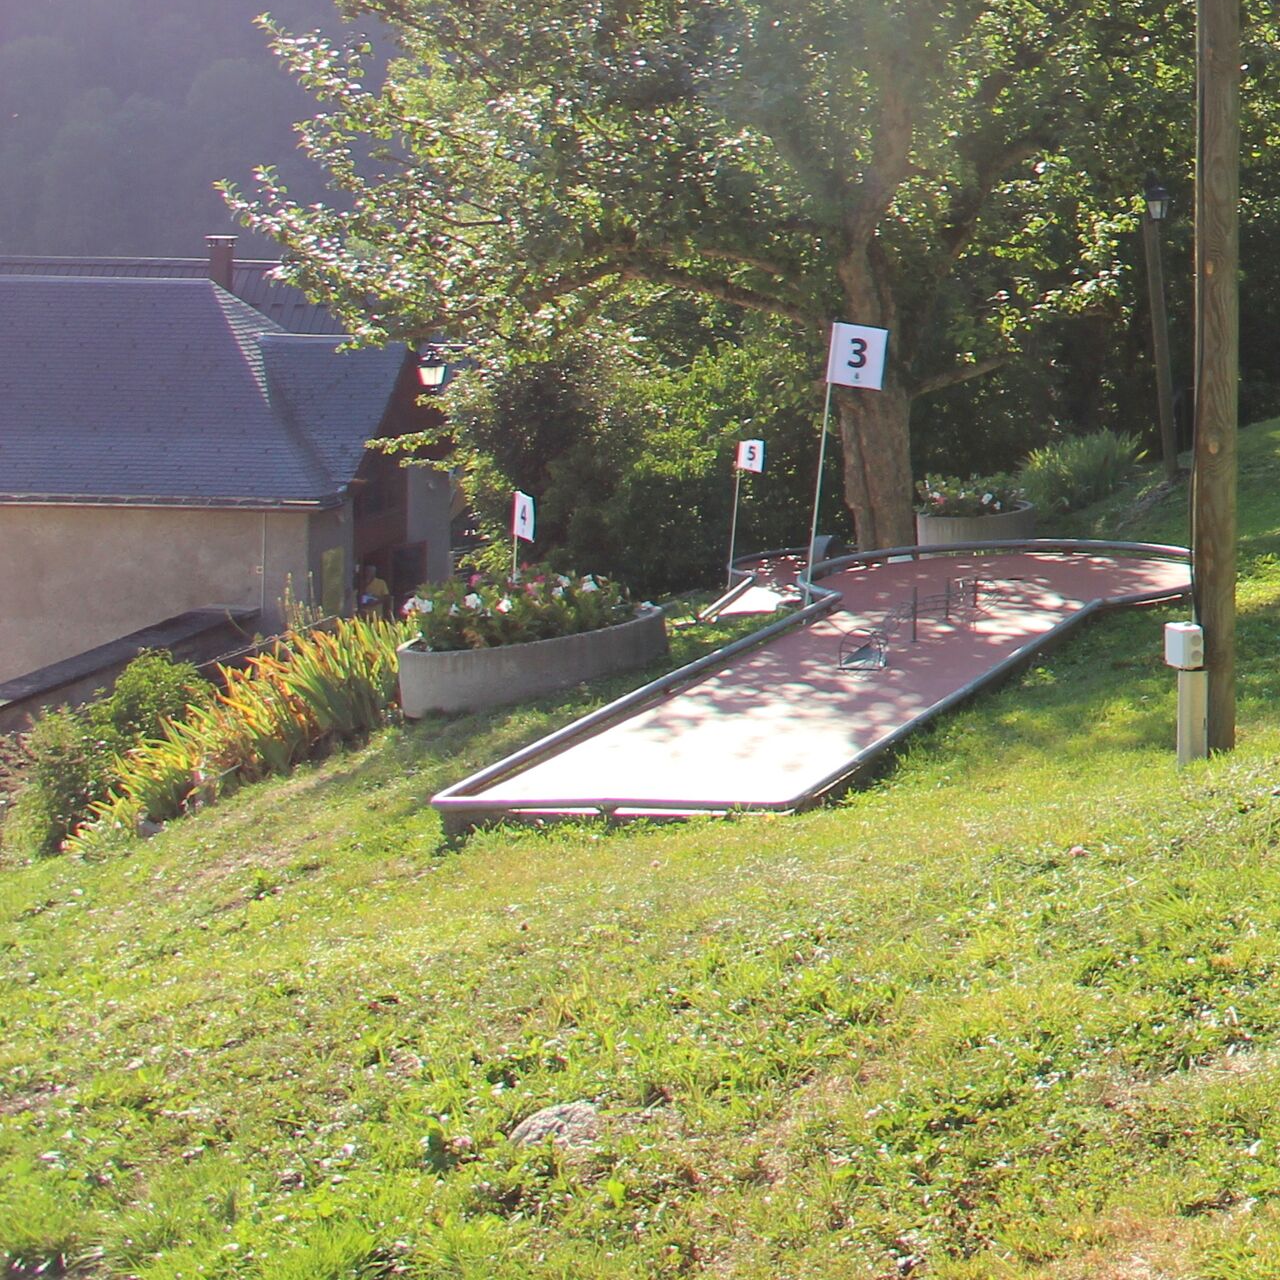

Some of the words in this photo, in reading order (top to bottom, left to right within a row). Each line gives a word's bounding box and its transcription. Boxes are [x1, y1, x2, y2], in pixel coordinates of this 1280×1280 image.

[847, 337, 867, 369] 3
[747, 445, 756, 461] 5
[520, 504, 527, 526] 4
